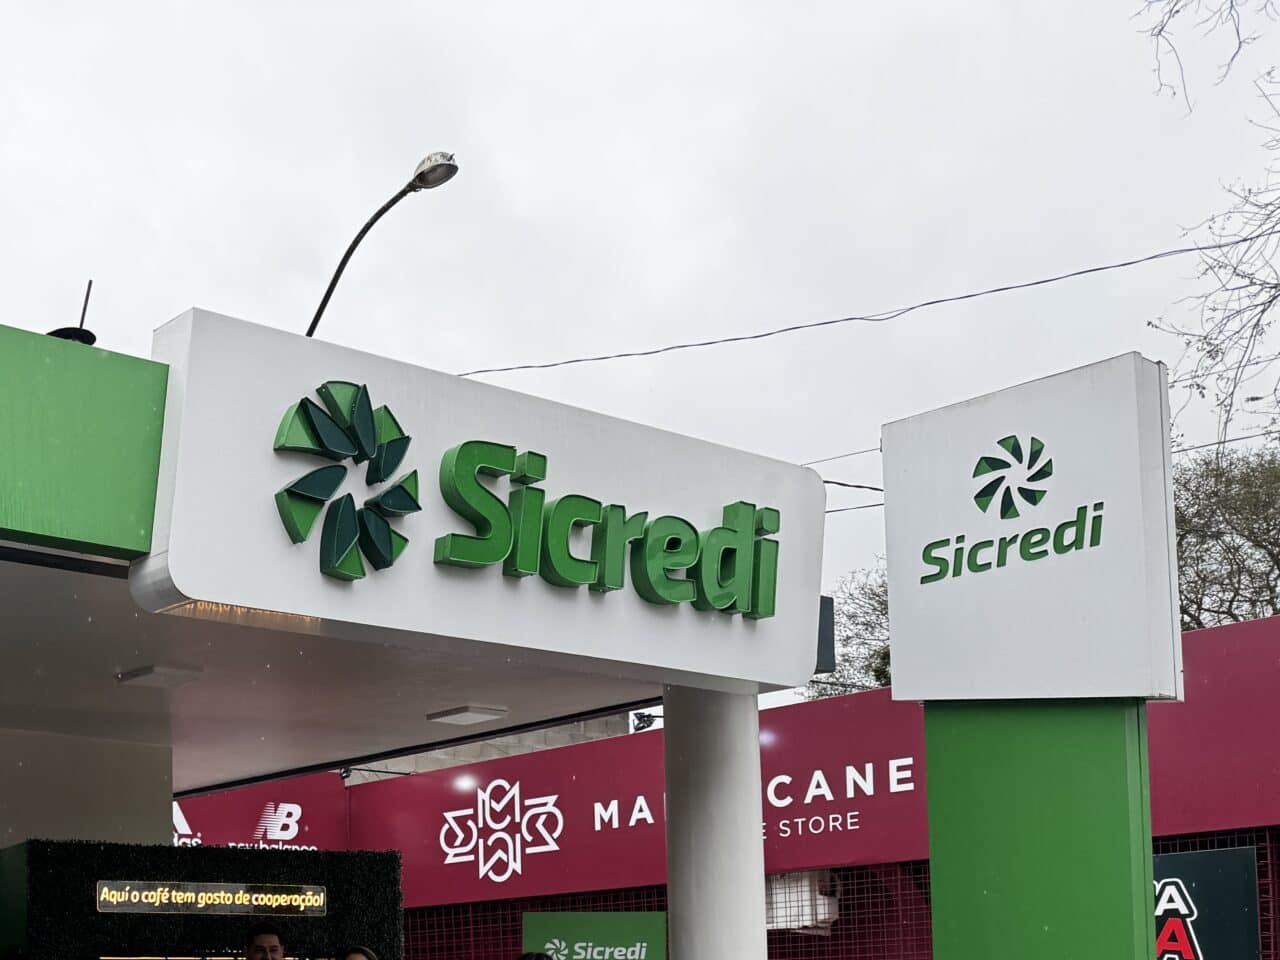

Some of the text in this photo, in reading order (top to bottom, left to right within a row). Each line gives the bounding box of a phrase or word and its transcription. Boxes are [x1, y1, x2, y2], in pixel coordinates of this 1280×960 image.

[433, 440, 780, 620] Sicredi
[919, 501, 1104, 585] Sicredi
[778, 811, 860, 838] STORE
[131, 890, 140, 903] o
[141, 887, 170, 908] café
[171, 889, 196, 905] tem
[197, 889, 233, 908] gosto
[234, 890, 251, 905] de
[573, 942, 647, 960] Sicredi
